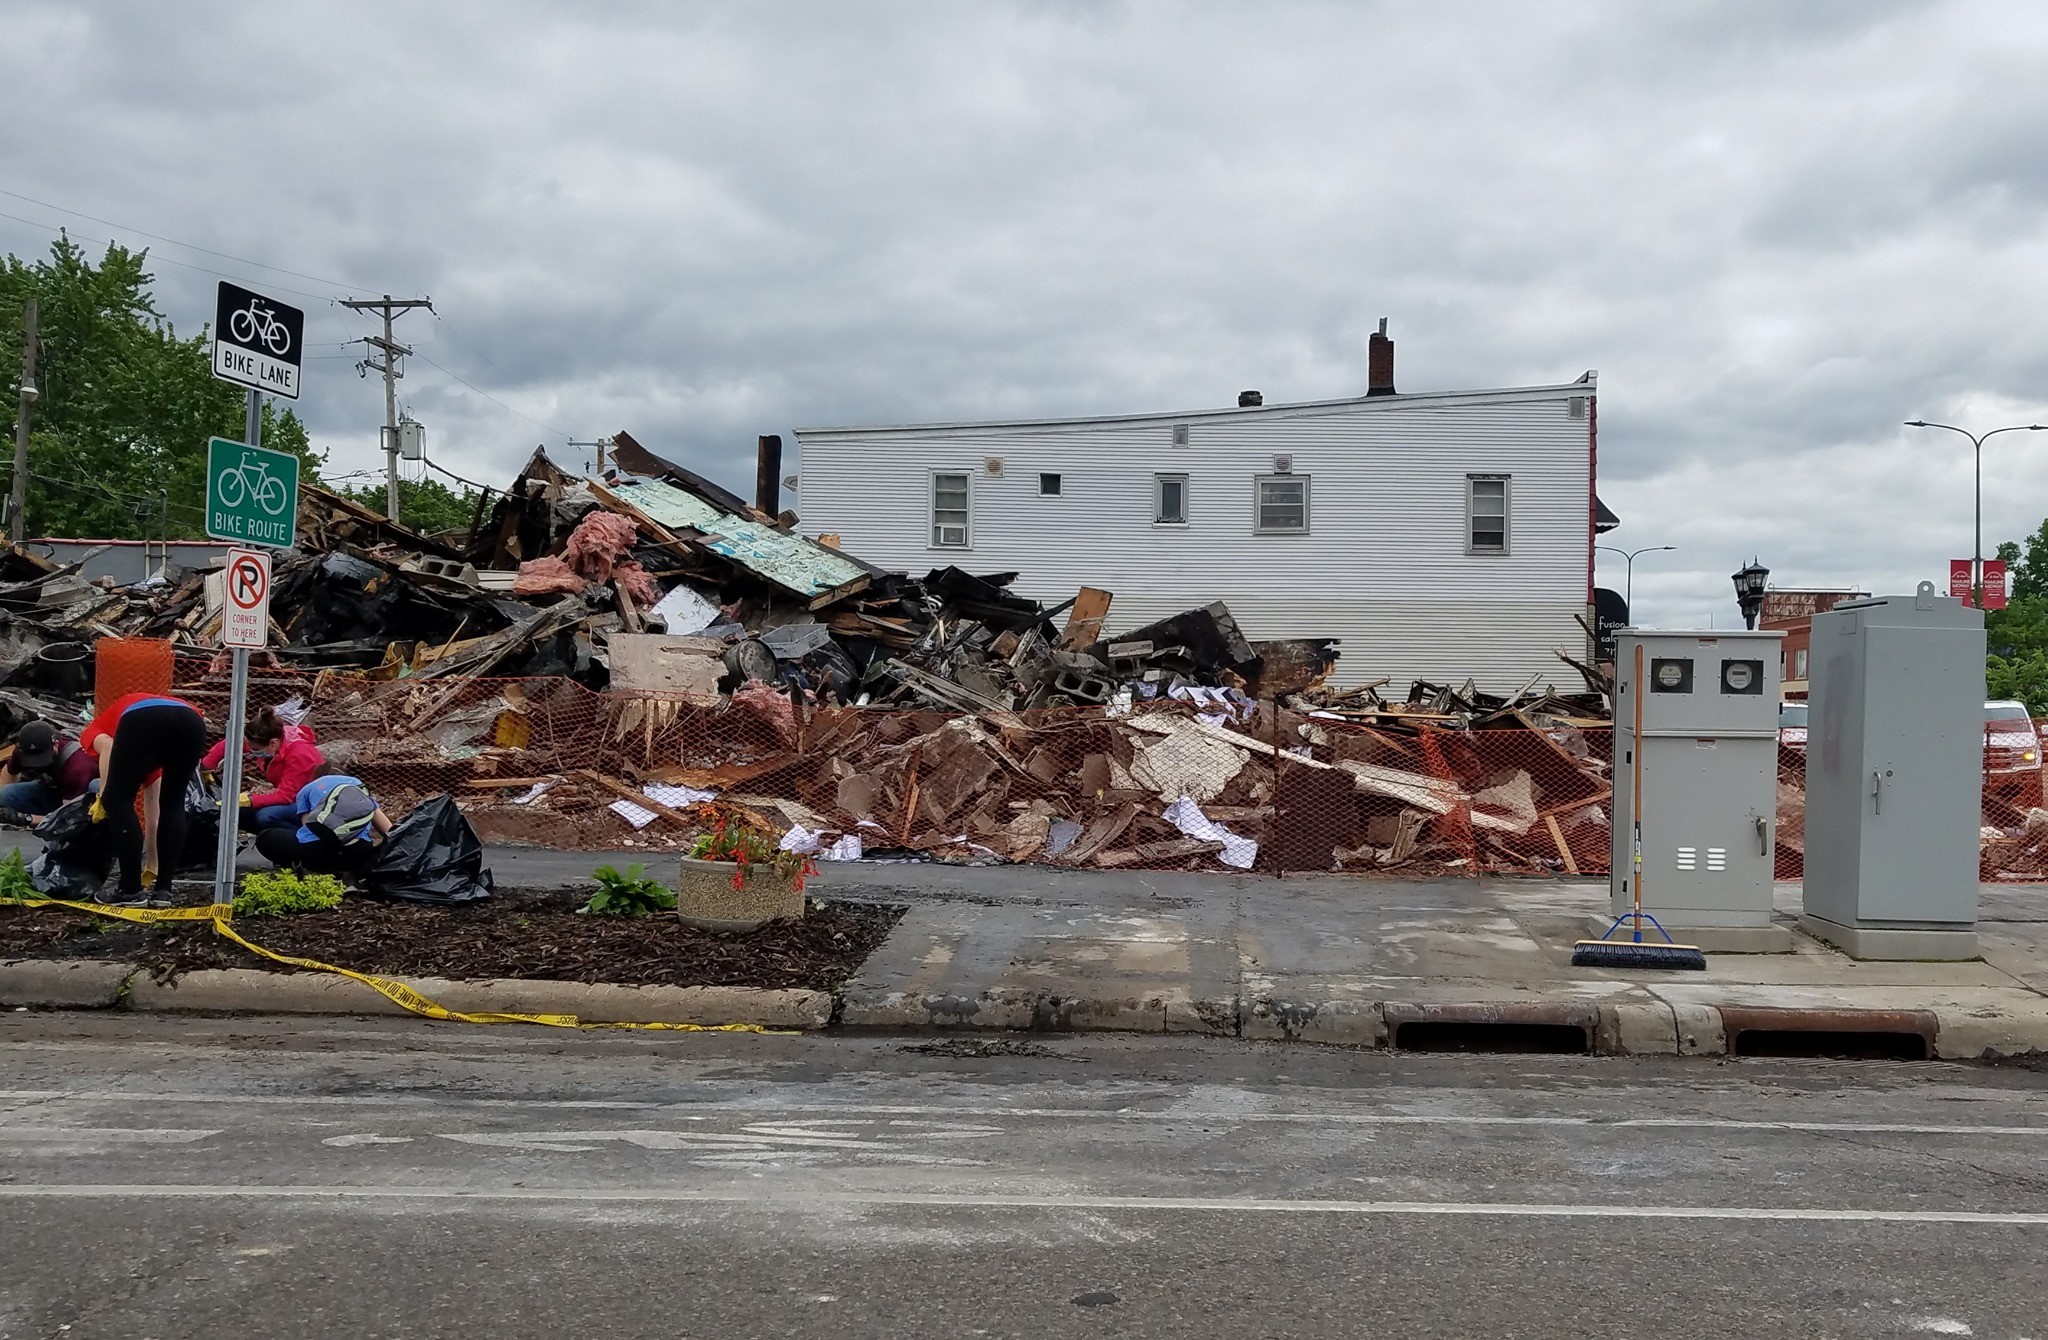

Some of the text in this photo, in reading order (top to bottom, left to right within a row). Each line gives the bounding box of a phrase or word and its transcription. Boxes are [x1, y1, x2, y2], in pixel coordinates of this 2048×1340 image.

[224, 350, 292, 388] BIKE LANE
[215, 512, 287, 541] BIKE ROUTE
[232, 613, 258, 625] CORNER
[1599, 616, 1626, 630] fusion
[232, 627, 257, 639] TO HERE
[376, 978, 390, 990] NOT
[388, 982, 401, 996] DO
[399, 988, 415, 1006] LINE
